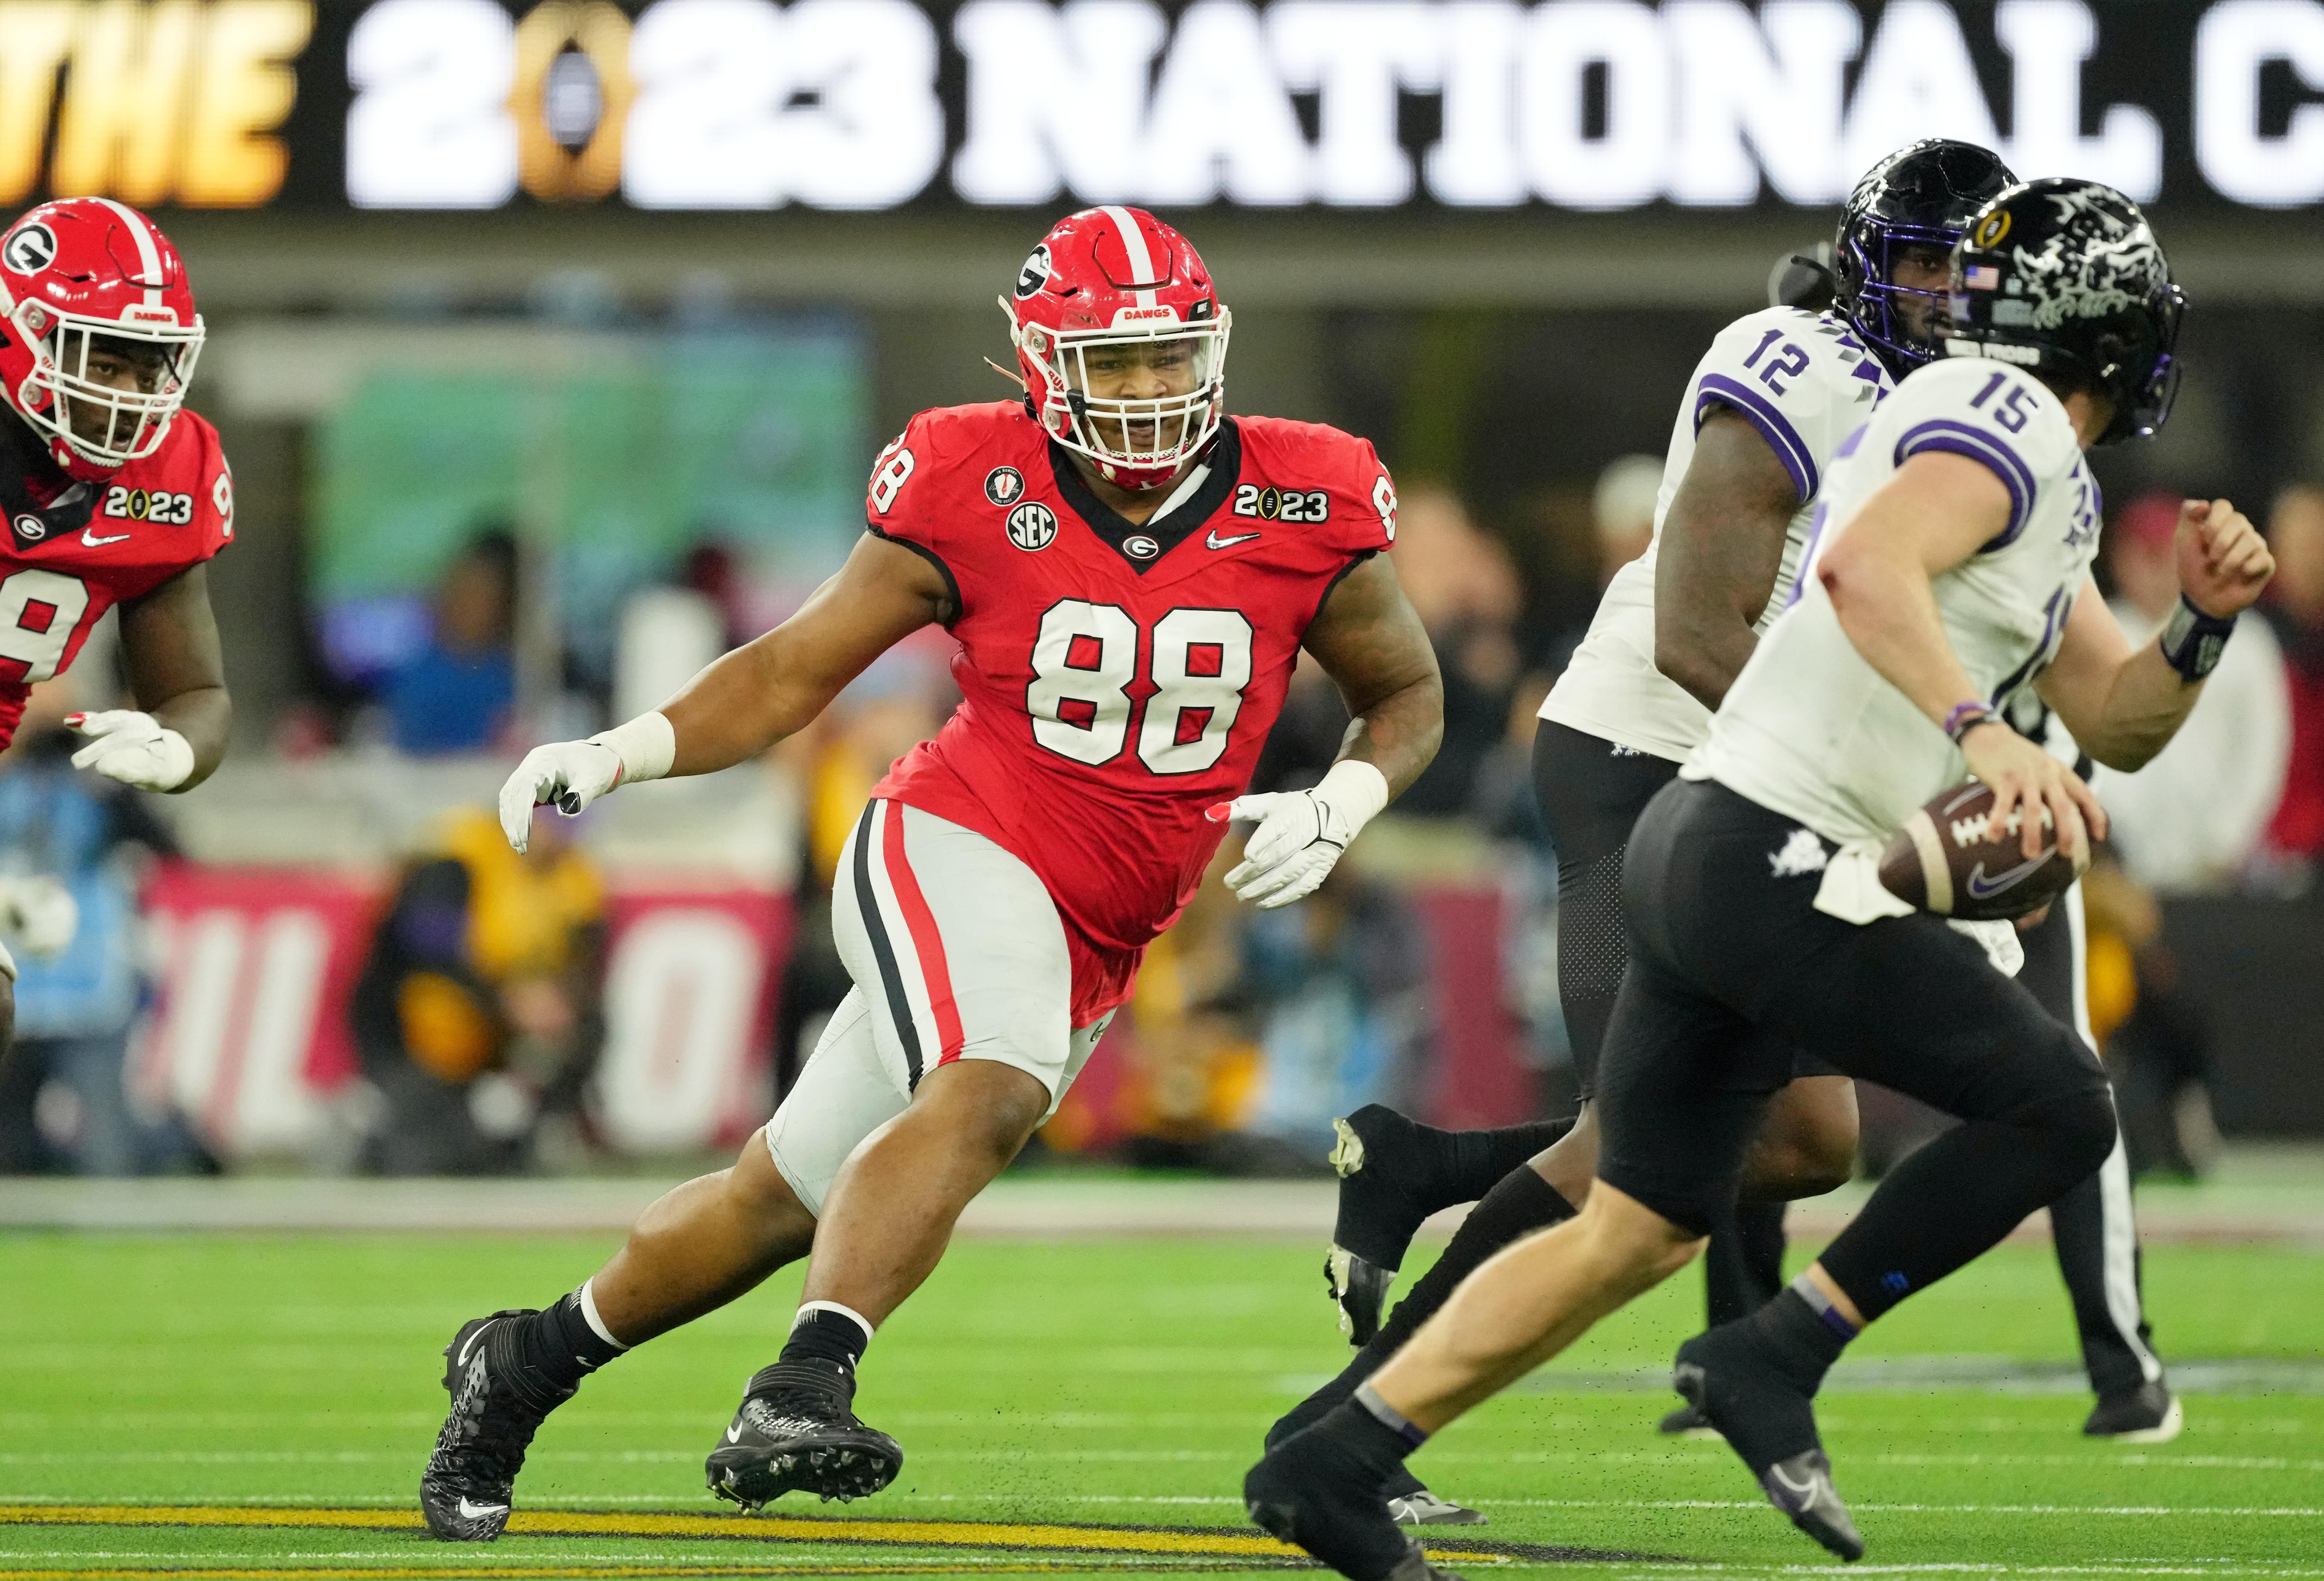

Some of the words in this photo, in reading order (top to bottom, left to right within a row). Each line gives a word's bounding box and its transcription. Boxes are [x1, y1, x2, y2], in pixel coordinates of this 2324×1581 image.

[0, 0, 317, 209] THE
[952, 0, 2163, 206] NATIONAL
[1124, 308, 1170, 320] DAWGS
[1744, 329, 1810, 397] 12
[1969, 372, 2040, 433] 15
[1010, 506, 1053, 548] SEC
[1027, 596, 1255, 776] 88
